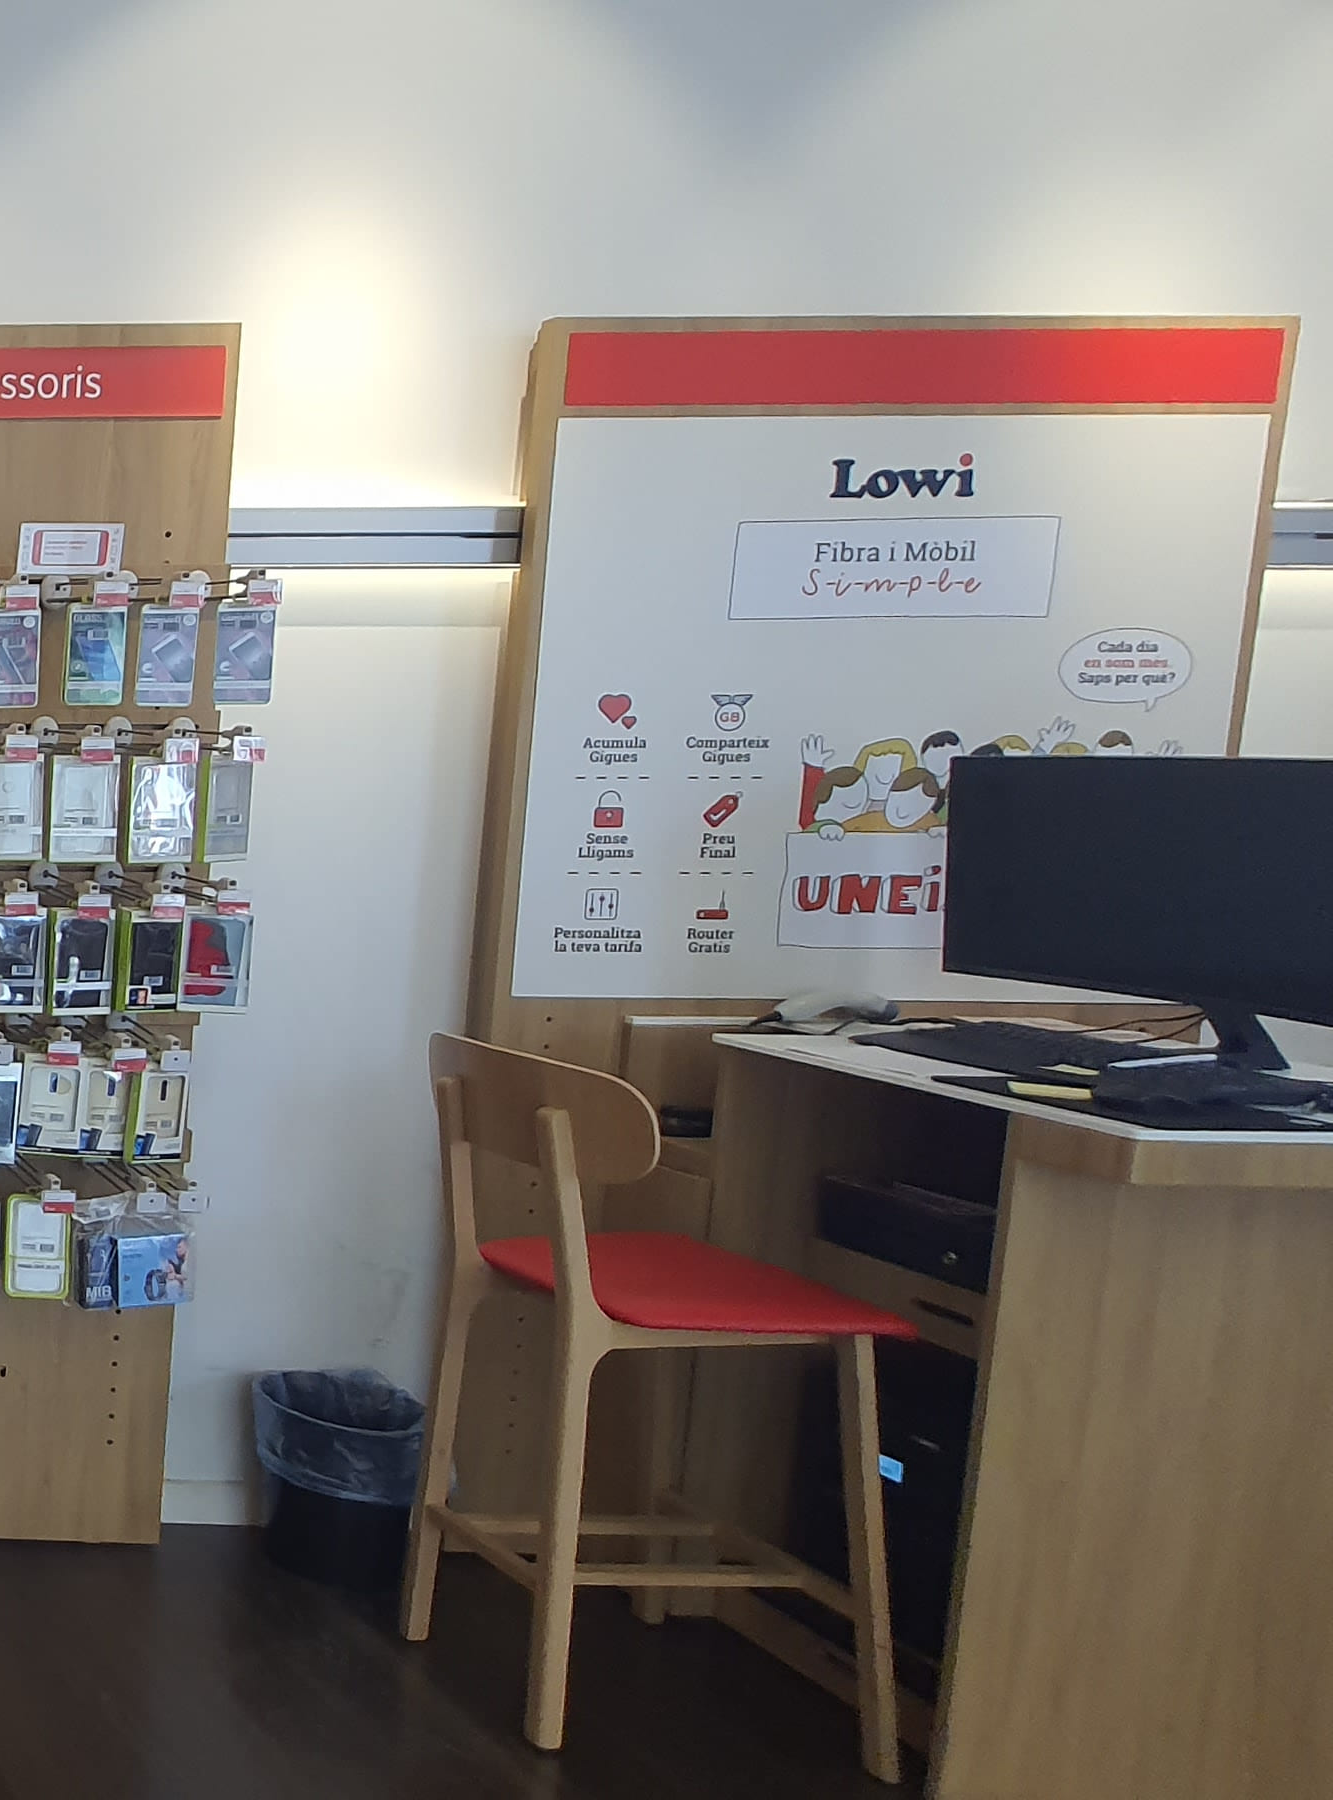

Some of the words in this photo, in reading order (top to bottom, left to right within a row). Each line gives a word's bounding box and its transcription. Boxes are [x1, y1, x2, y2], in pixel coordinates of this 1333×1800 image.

[829, 452, 975, 499] Lowi
[813, 541, 881, 563] Fibra
[888, 540, 896, 563] i
[1097, 640, 1133, 653] Cada
[1136, 640, 1159, 653] dia
[1078, 671, 1112, 686] Saps
[1115, 674, 1139, 686] per
[719, 711, 740, 723] GB
[583, 736, 647, 749] Acumula
[686, 736, 770, 751] Comparteix
[589, 751, 638, 765] Gigues
[702, 751, 751, 765] Gigues
[586, 832, 628, 845] Sense
[702, 832, 735, 845] Preu
[578, 846, 634, 861] Lligams
[699, 846, 736, 859] Final
[553, 927, 642, 940] Personalitza
[687, 927, 735, 940] Router
[554, 940, 569, 953] la
[571, 942, 601, 953] teva
[604, 940, 643, 953] tarifa
[687, 941, 731, 953] Gratis
